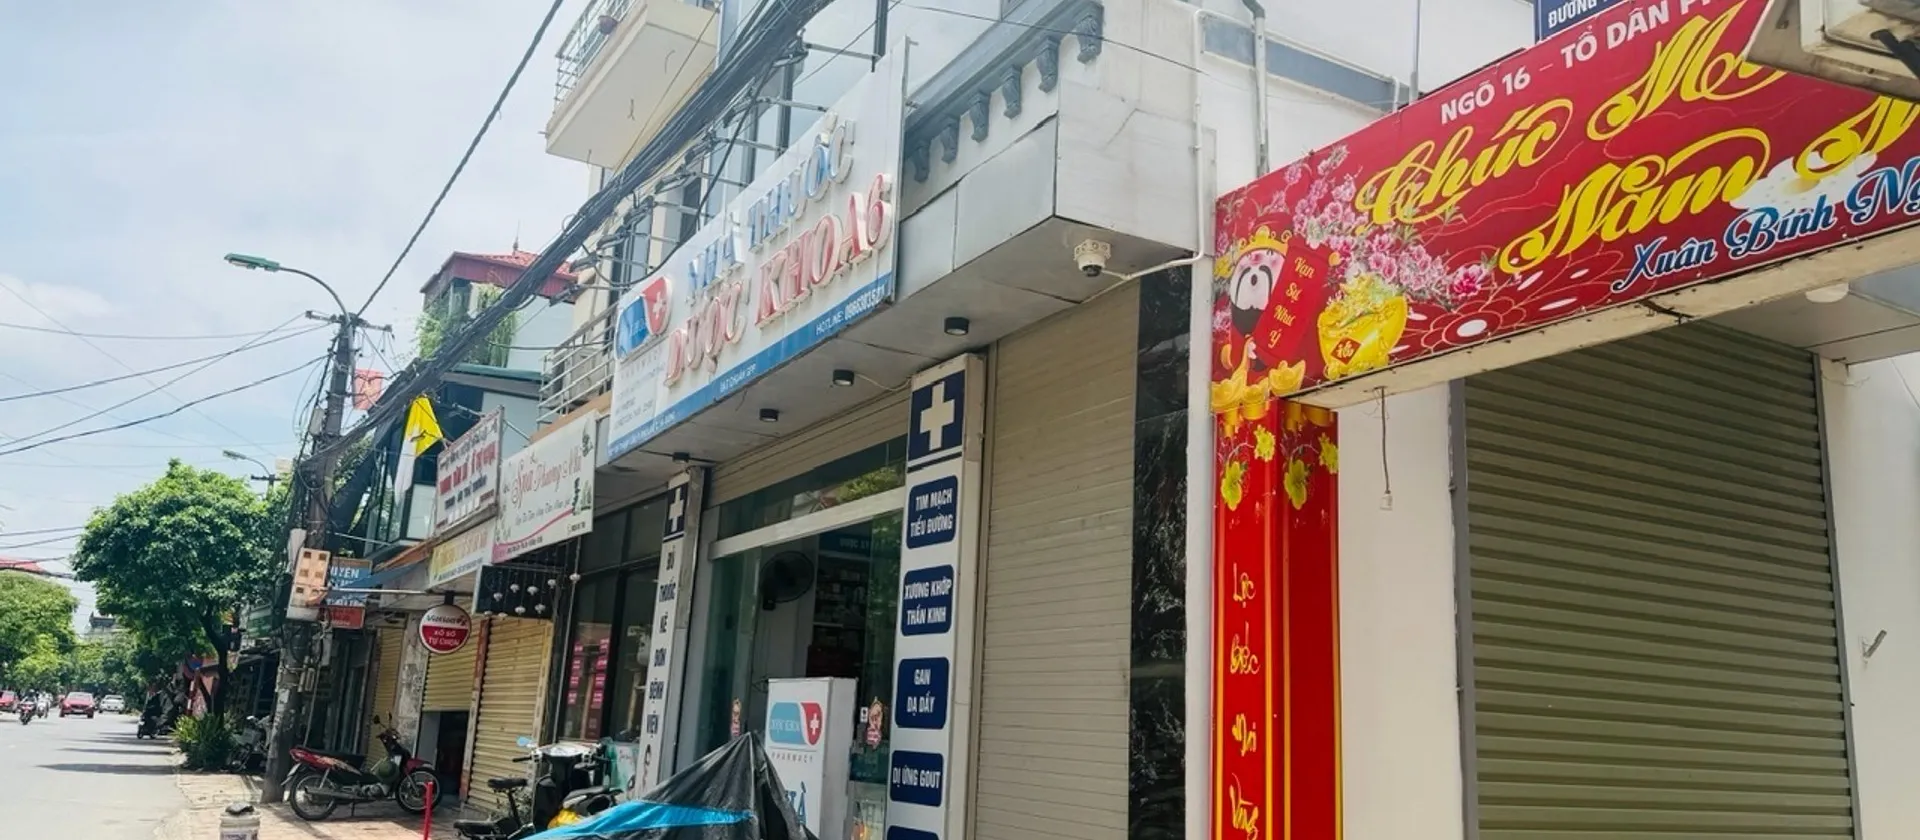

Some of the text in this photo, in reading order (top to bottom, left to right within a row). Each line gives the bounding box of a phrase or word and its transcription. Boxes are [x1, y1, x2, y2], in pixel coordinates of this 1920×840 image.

[1441, 80, 1496, 124] NGÕ
[1502, 66, 1531, 95] 16
[1561, 25, 1597, 69] TỔ
[1606, 1, 1669, 50] DÂN
[748, 112, 856, 252] THUỐC
[1355, 98, 1574, 225] Chúc
[1499, 128, 1771, 274] Năm
[1610, 236, 1718, 294] Xuân
[1724, 193, 1838, 260] Bính
[1268, 256, 1315, 348] Vạn Sự Như Ý
[664, 278, 751, 388] DƯỢC
[915, 488, 952, 511] TIM MẠCH
[927, 513, 953, 534] ĐƯỜNG
[927, 606, 946, 623] KINH
[930, 576, 952, 597] KHỚP
[914, 669, 931, 685] GAN
[907, 696, 918, 716] DẠ
[892, 765, 941, 788] DỊ ỨNG GOUT
